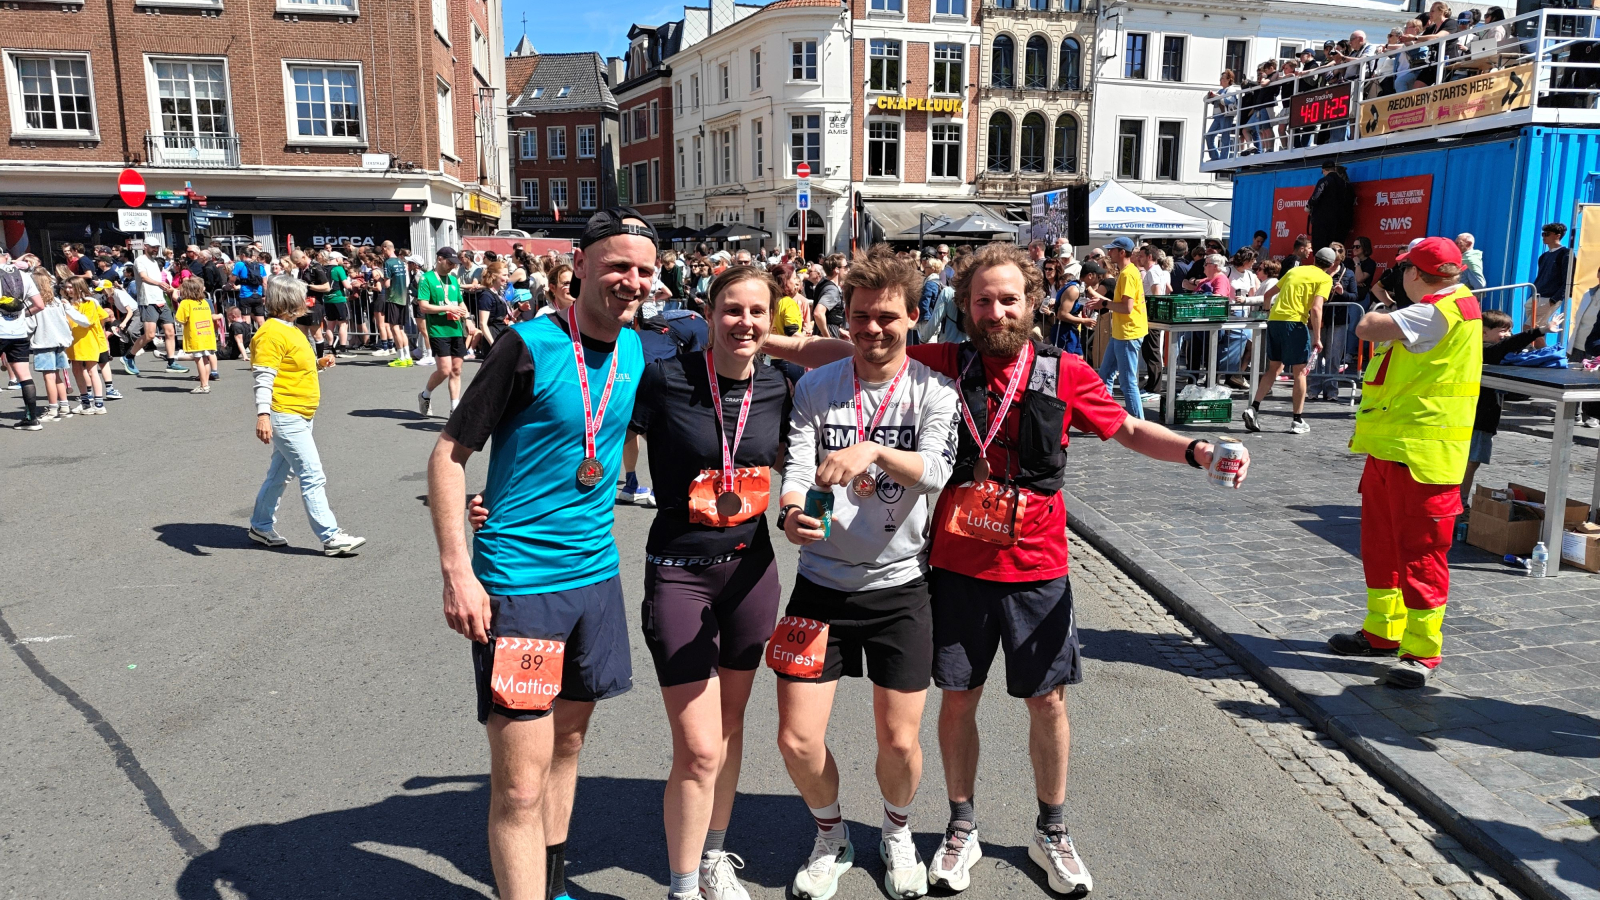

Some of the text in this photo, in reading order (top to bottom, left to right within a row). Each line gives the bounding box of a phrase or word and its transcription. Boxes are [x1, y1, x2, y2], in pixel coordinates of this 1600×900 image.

[1315, 93, 1333, 101] Tracking
[1387, 78, 1495, 111] RECOVERY STARTS HERE
[1300, 95, 1349, 124] 4:01:25
[312, 235, 375, 246] BOCCA
[981, 496, 1001, 511] 61
[885, 508, 896, 522] X
[966, 510, 1010, 534] Lukas
[786, 629, 806, 645] 60
[520, 653, 544, 671] 89
[772, 644, 816, 667] Ernest
[494, 673, 560, 696] Mattias
